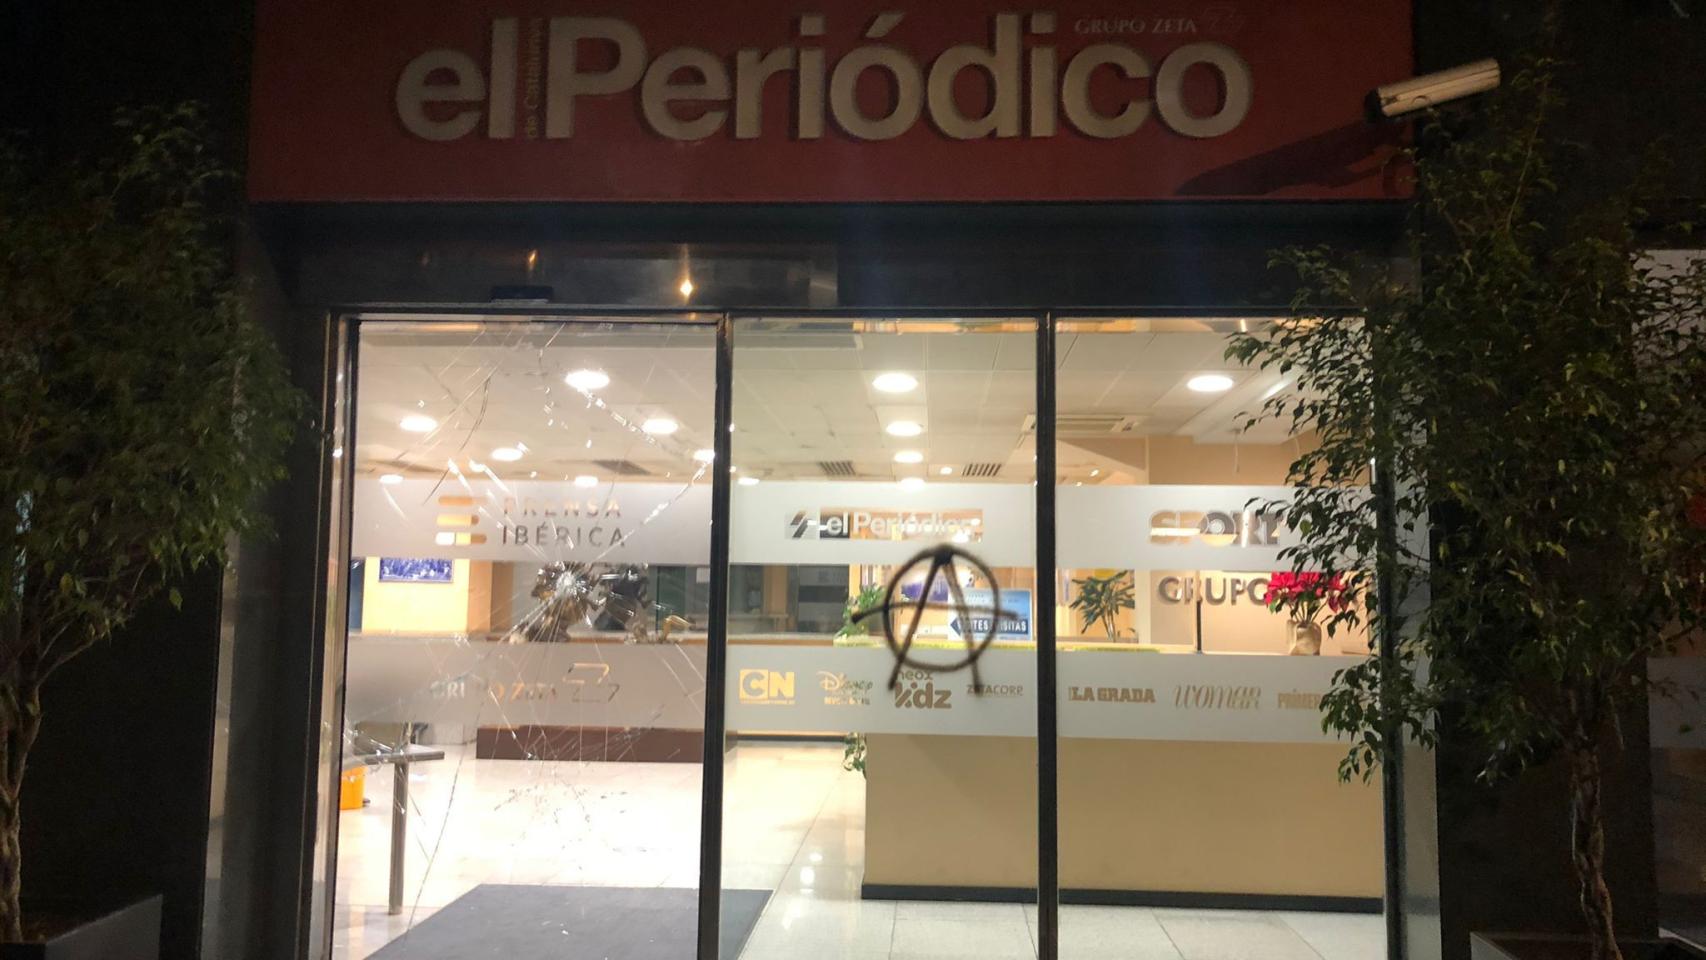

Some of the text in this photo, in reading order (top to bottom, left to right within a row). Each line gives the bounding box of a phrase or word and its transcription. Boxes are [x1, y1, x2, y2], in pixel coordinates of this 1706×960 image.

[1074, 17, 1198, 35] GRUPO ZETA
[503, 496, 622, 518] PRENSA
[502, 520, 626, 548] IBÉRICA
[740, 669, 795, 701] CN
[967, 684, 1024, 696] ZTACORP
[1069, 686, 1157, 703] LA GRADA
